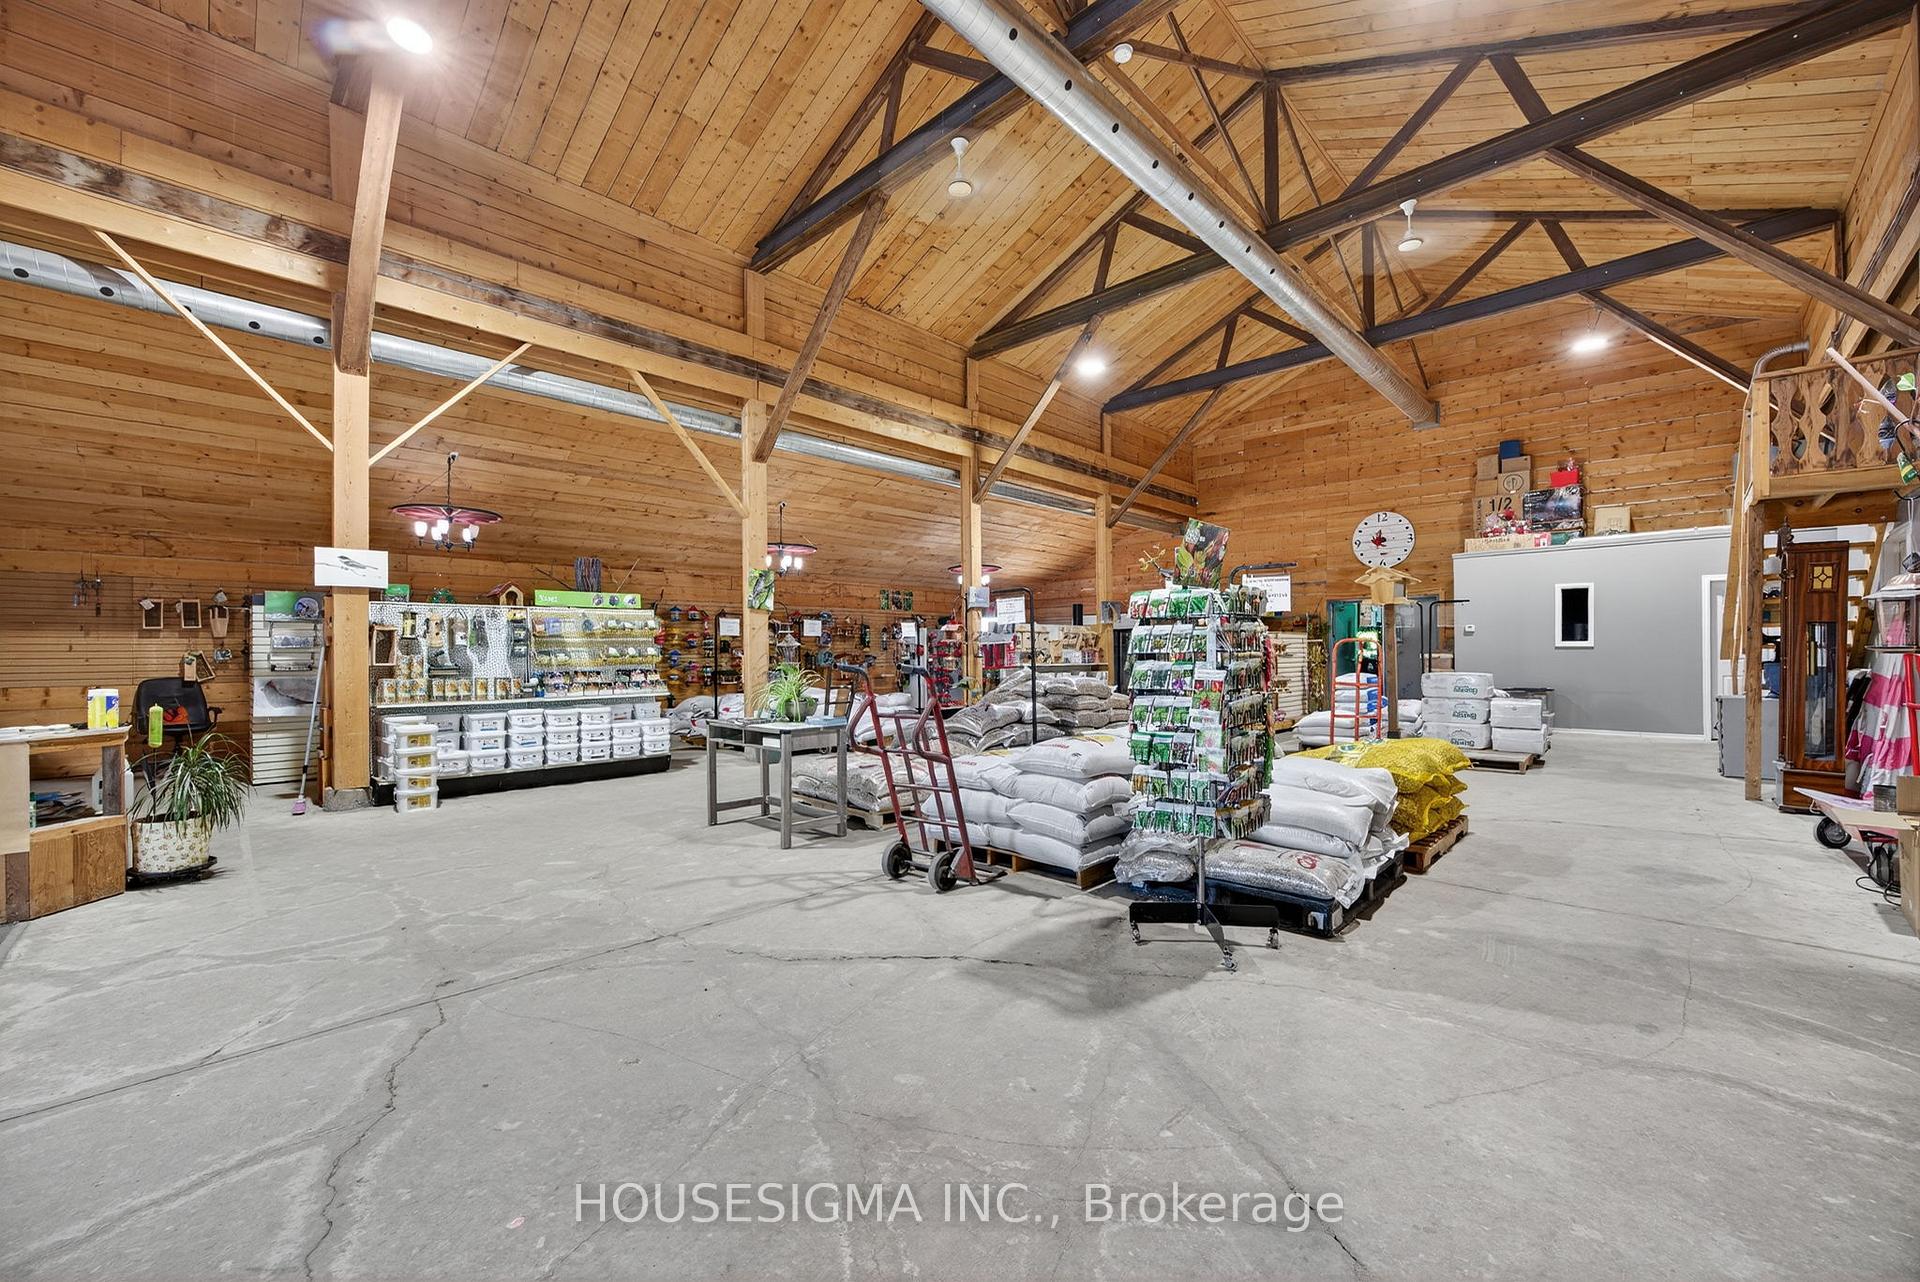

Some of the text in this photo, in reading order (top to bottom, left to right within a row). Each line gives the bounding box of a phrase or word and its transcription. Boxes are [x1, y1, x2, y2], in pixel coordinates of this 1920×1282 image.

[1489, 497, 1512, 512] 1/2
[1377, 512, 1388, 523] 12
[1354, 539, 1362, 549] 9
[1407, 533, 1414, 544] 3
